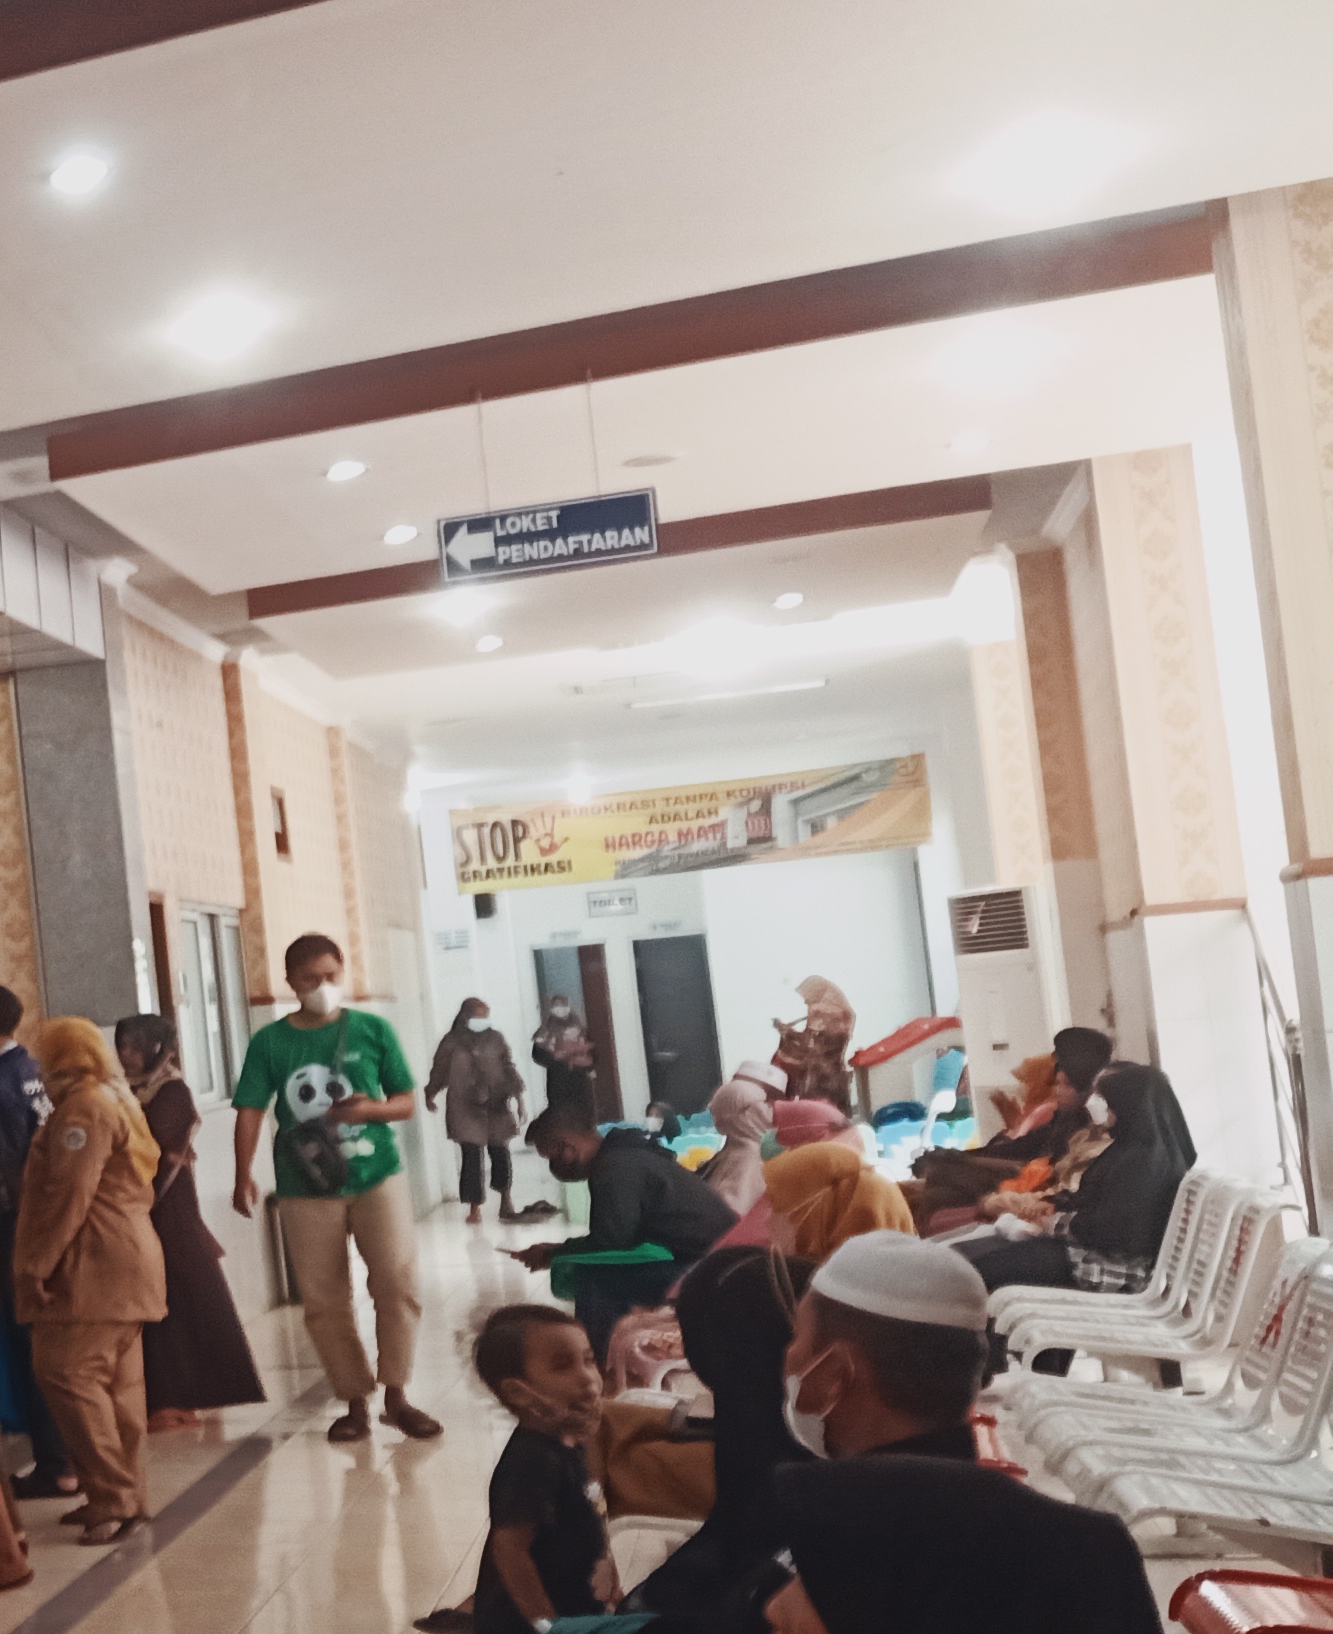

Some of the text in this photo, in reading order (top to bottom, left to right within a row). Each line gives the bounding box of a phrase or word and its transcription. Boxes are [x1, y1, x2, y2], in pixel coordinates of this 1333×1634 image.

[495, 510, 561, 537] LOKET
[497, 525, 651, 564] PENDAFTARAN
[662, 791, 718, 807] TANPA
[648, 806, 719, 825] ADALAH
[455, 818, 531, 868] STOP
[603, 829, 671, 853] HARGA
[460, 860, 573, 883] GRATIFIKASI
